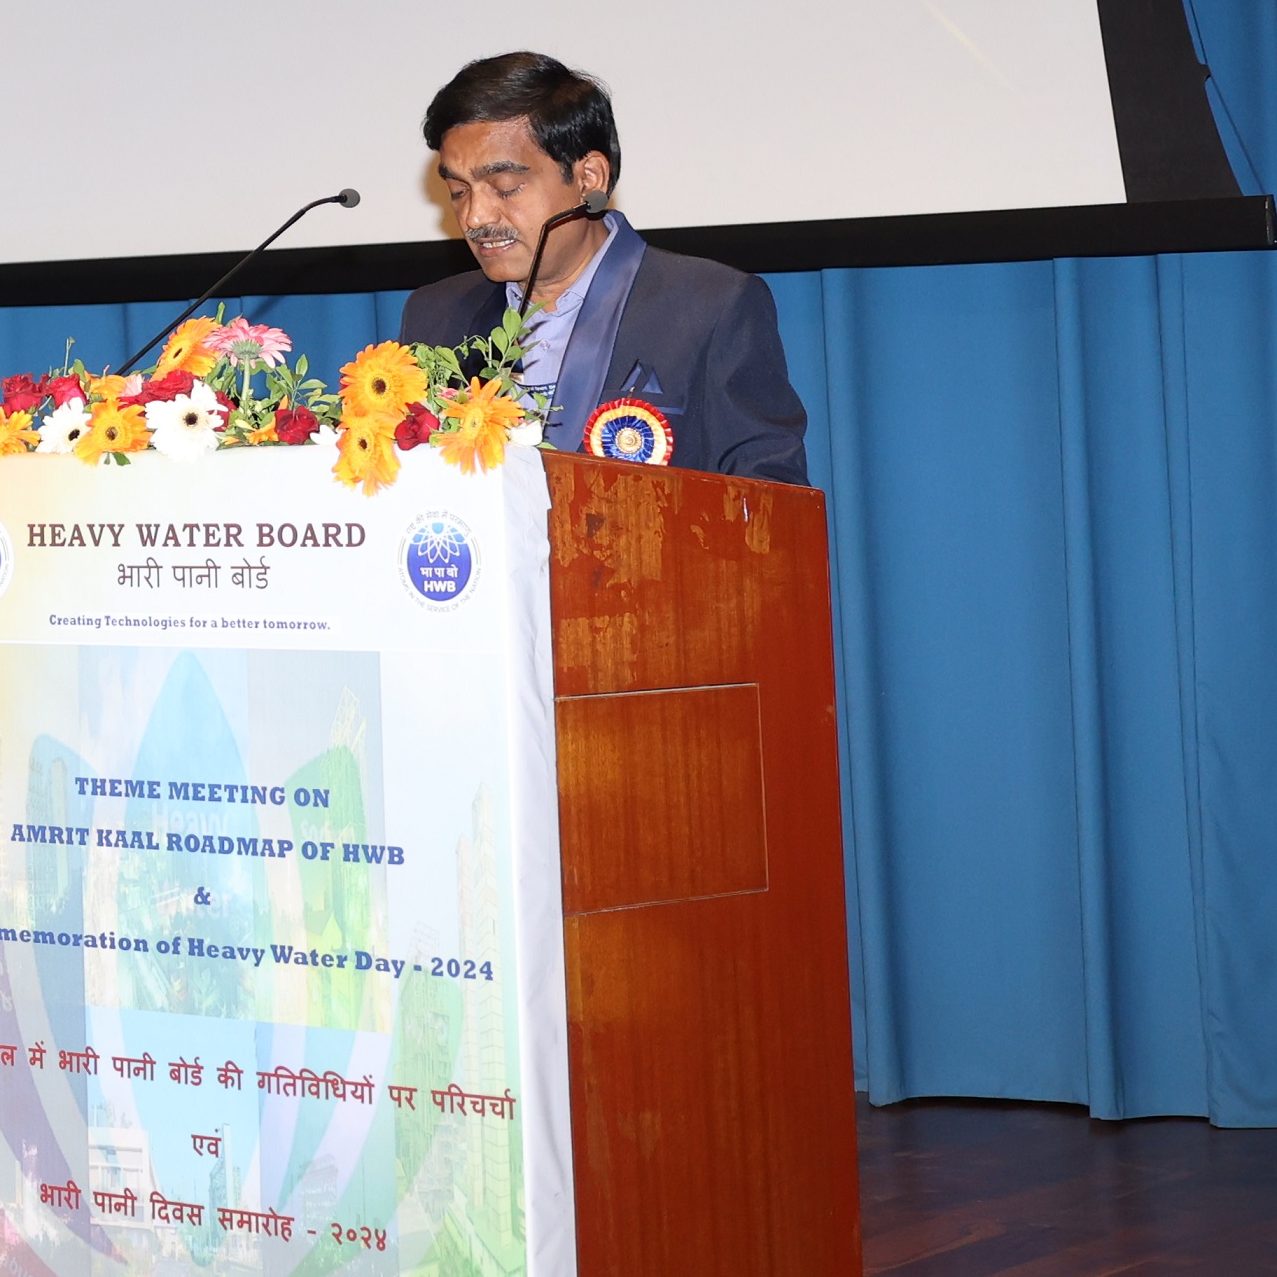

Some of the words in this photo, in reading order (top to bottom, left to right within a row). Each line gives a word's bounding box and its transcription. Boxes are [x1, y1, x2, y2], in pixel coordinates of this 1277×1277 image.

[27, 523, 125, 548] HEAVY
[136, 523, 245, 548] WATER
[256, 523, 366, 548] BOARD
[117, 557, 163, 589] भारी
[171, 558, 221, 589] पानी
[230, 556, 270, 590] बोर्ड
[423, 580, 457, 592] HWB
[49, 615, 102, 630] Creating
[104, 616, 187, 630] Technologies
[189, 616, 208, 628] for
[211, 619, 218, 628] a
[221, 617, 260, 630] better
[263, 619, 331, 630] tomorrow.
[75, 777, 161, 799] THEME
[168, 781, 286, 808] MEETING
[294, 788, 330, 808] ON
[10, 824, 89, 846] AMRIT
[96, 829, 160, 851] KAAL
[166, 833, 293, 859] ROADMAP
[301, 840, 335, 861] OF
[342, 843, 405, 865] HWB
[194, 886, 211, 905] &
[156, 936, 182, 955] of
[187, 937, 265, 966] Heavy
[270, 944, 347, 969] Water
[355, 951, 406, 978] Day
[431, 957, 494, 981] 2024
[28, 1040, 46, 1069] में
[58, 1046, 99, 1075] भारी
[111, 1052, 156, 1081] पानी
[168, 1055, 204, 1086] बोर्ड
[216, 1060, 244, 1090] की
[256, 1065, 374, 1104] गतिविधियों
[388, 1085, 418, 1111] पर
[431, 1083, 517, 1120] परिचर्चा
[191, 1127, 222, 1158] एवं
[40, 1179, 82, 1210] भारी
[93, 1187, 136, 1218] पानी
[150, 1191, 204, 1226] दिवस
[217, 1205, 295, 1241] समारोह
[331, 1222, 387, 1251] २०२४
